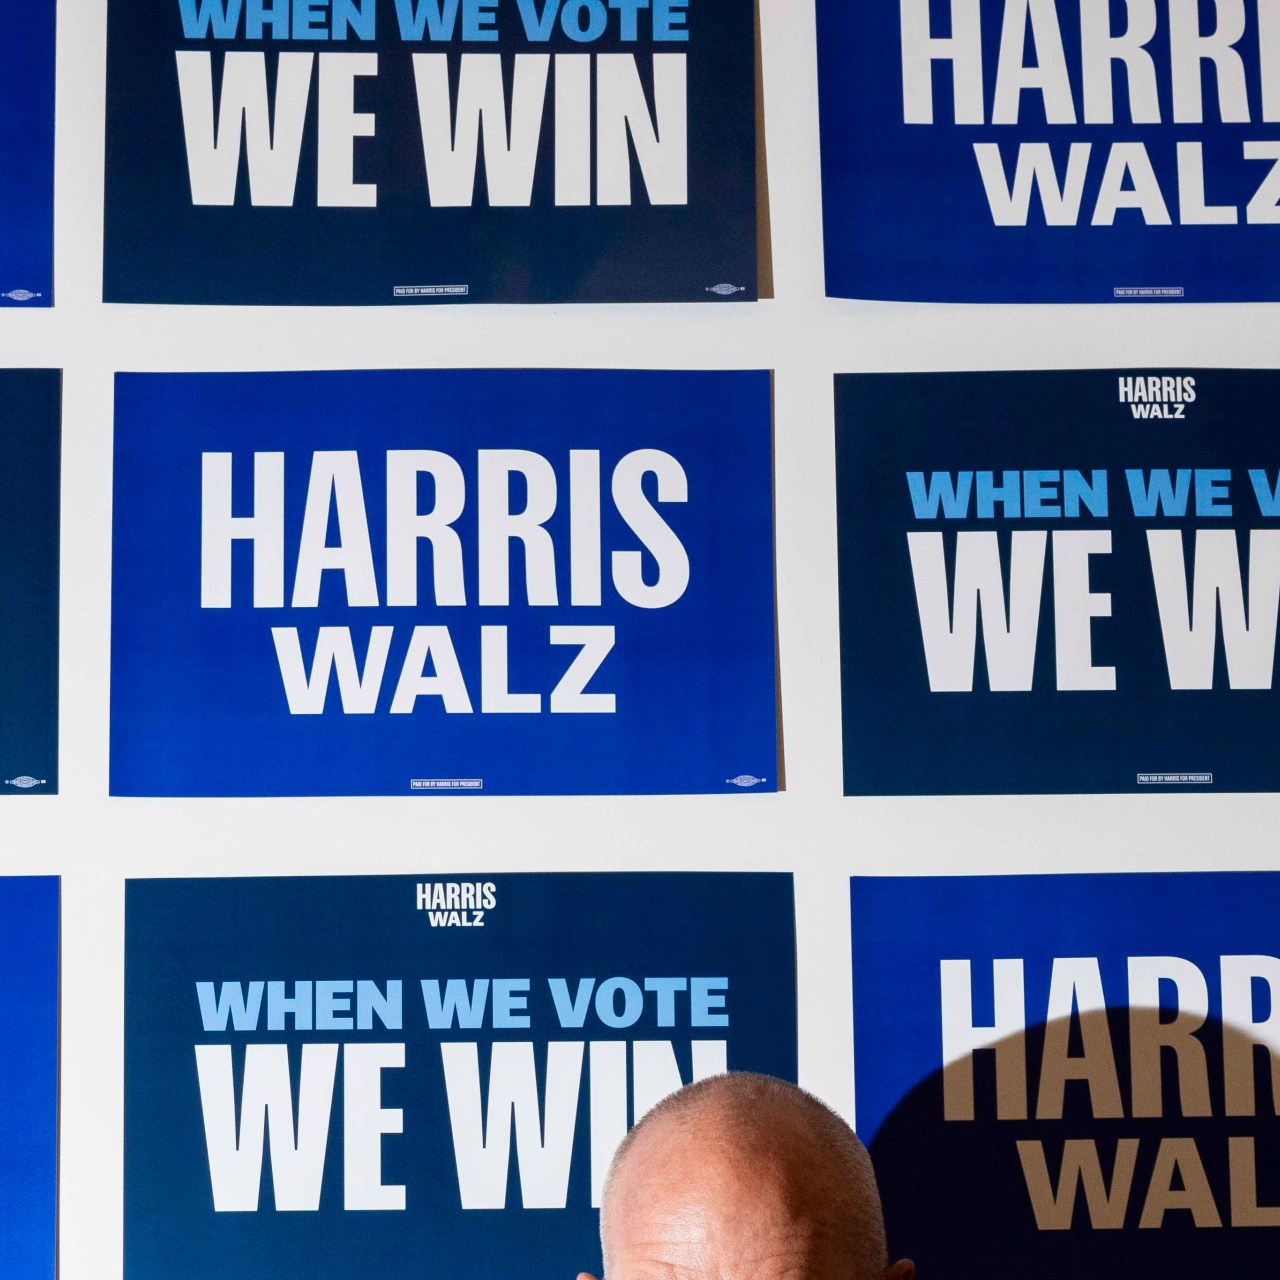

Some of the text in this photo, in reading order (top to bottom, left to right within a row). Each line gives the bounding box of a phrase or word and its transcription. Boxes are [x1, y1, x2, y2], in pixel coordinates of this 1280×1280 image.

[179, 0, 689, 42] WHEN WE VOTE
[176, 51, 687, 207] WE WIN
[1118, 376, 1196, 403] HARRIS
[1130, 404, 1185, 419] WALZ
[906, 470, 1108, 519] WHEN
[1125, 469, 1232, 516] WE
[201, 449, 689, 608] HARRIS
[907, 530, 1116, 692] WE
[271, 626, 616, 714] WALZ
[417, 882, 496, 911] HARRIS
[428, 911, 484, 927] WALZ
[196, 977, 728, 1031] WHEN WE VOTE
[195, 1043, 406, 1211] WE
